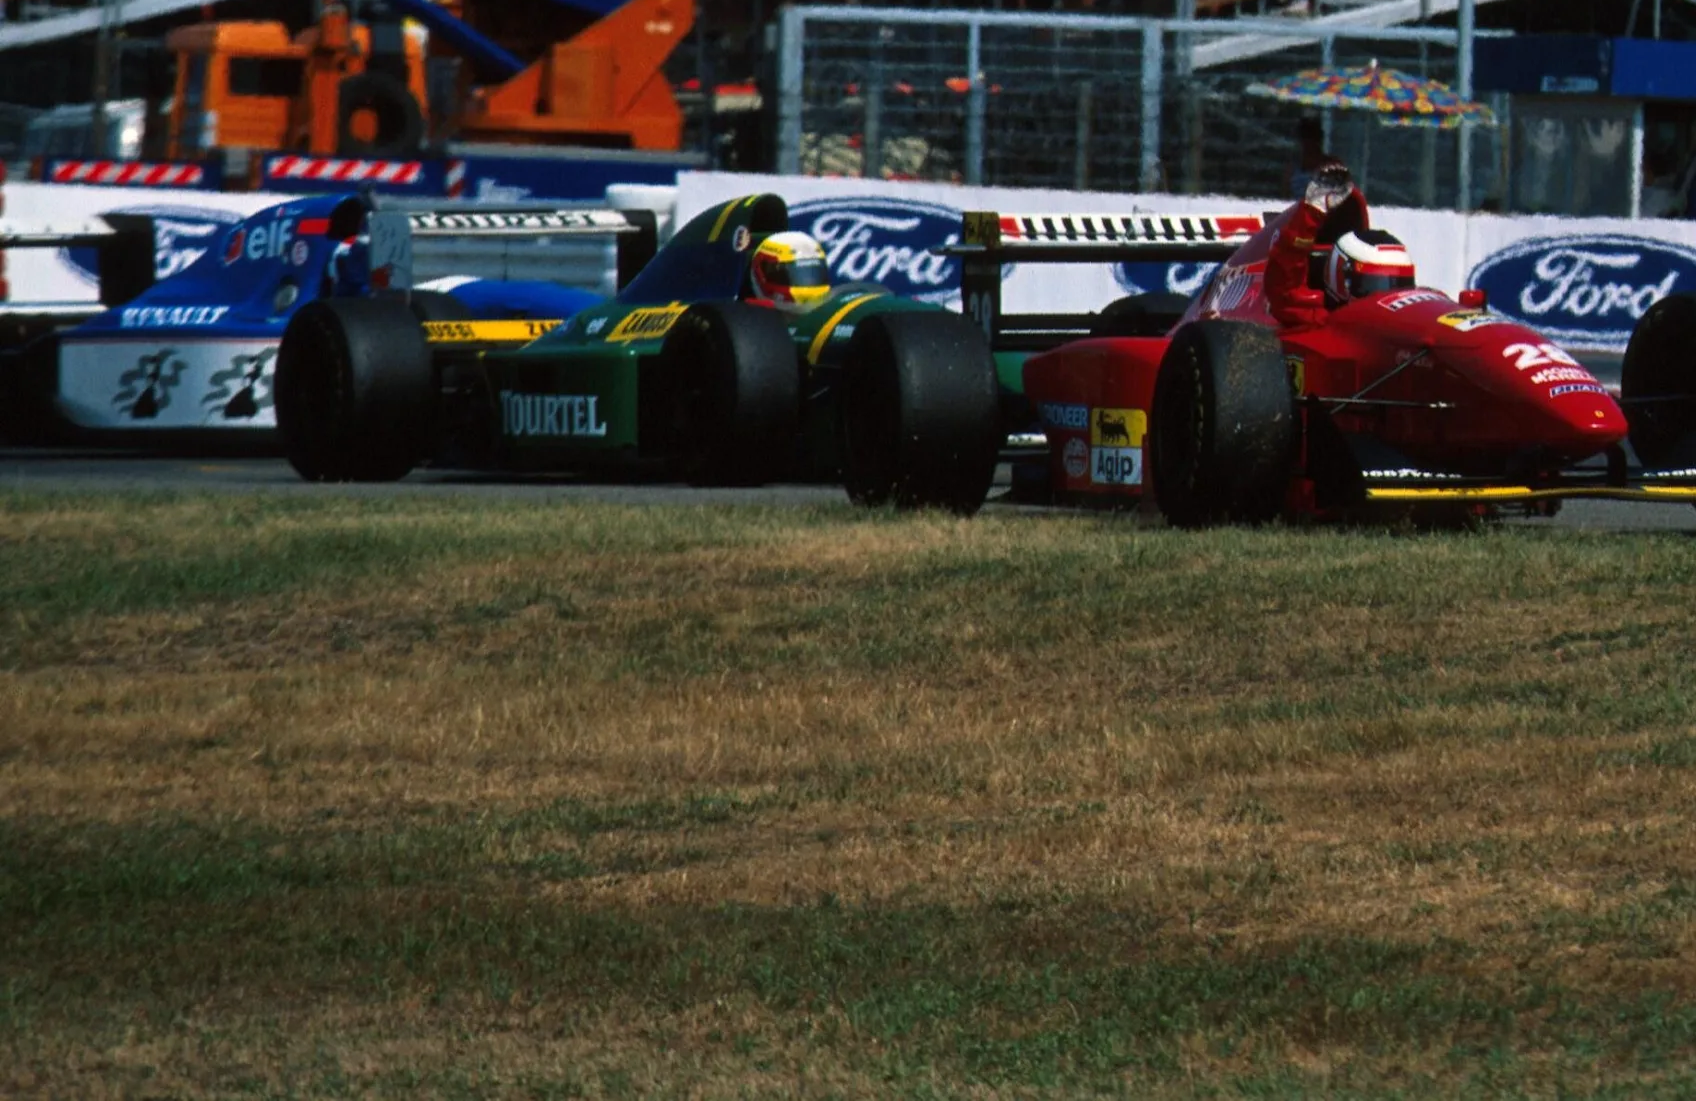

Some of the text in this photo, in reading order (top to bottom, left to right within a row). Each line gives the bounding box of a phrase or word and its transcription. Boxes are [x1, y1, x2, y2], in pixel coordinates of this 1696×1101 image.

[247, 219, 293, 259] elf
[1520, 249, 1680, 318] Ford
[120, 305, 231, 328] RENAULT
[500, 391, 606, 437] TOURTEL
[1097, 449, 1134, 482] Agip
